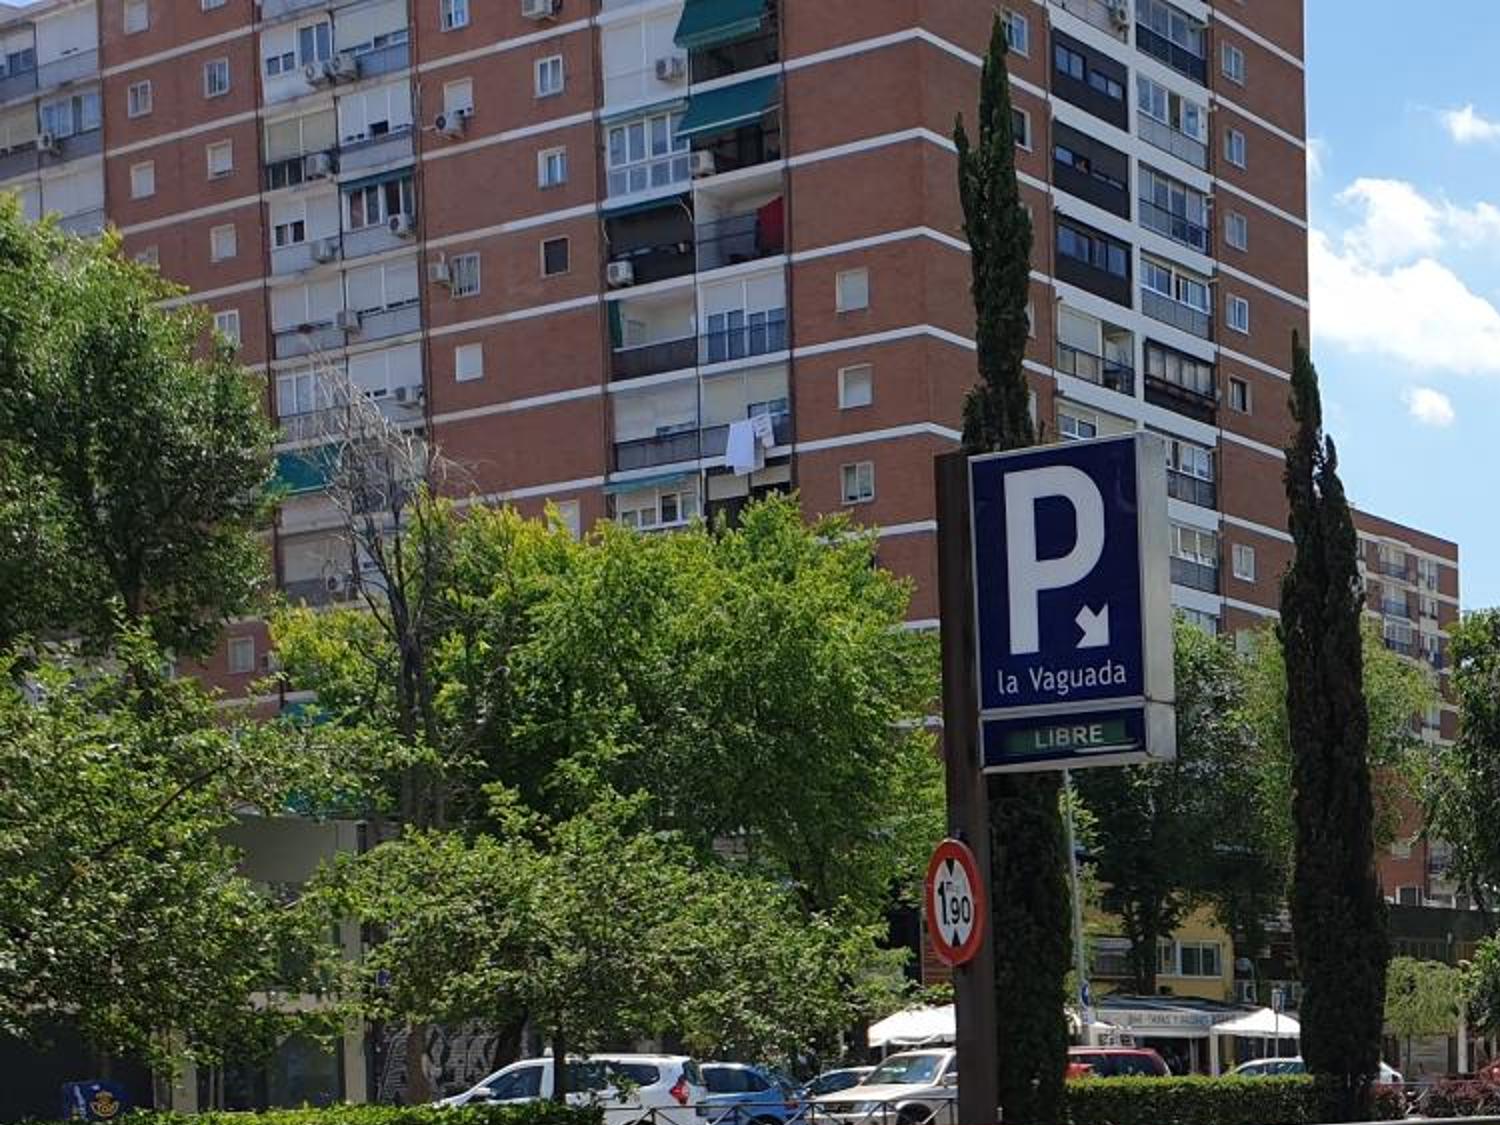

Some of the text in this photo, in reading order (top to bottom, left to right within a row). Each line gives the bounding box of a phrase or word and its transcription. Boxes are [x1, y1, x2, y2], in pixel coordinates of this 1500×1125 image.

[1004, 465, 1105, 655] P
[998, 659, 1127, 695] la Vaguada
[1035, 724, 1105, 749] LIBRE
